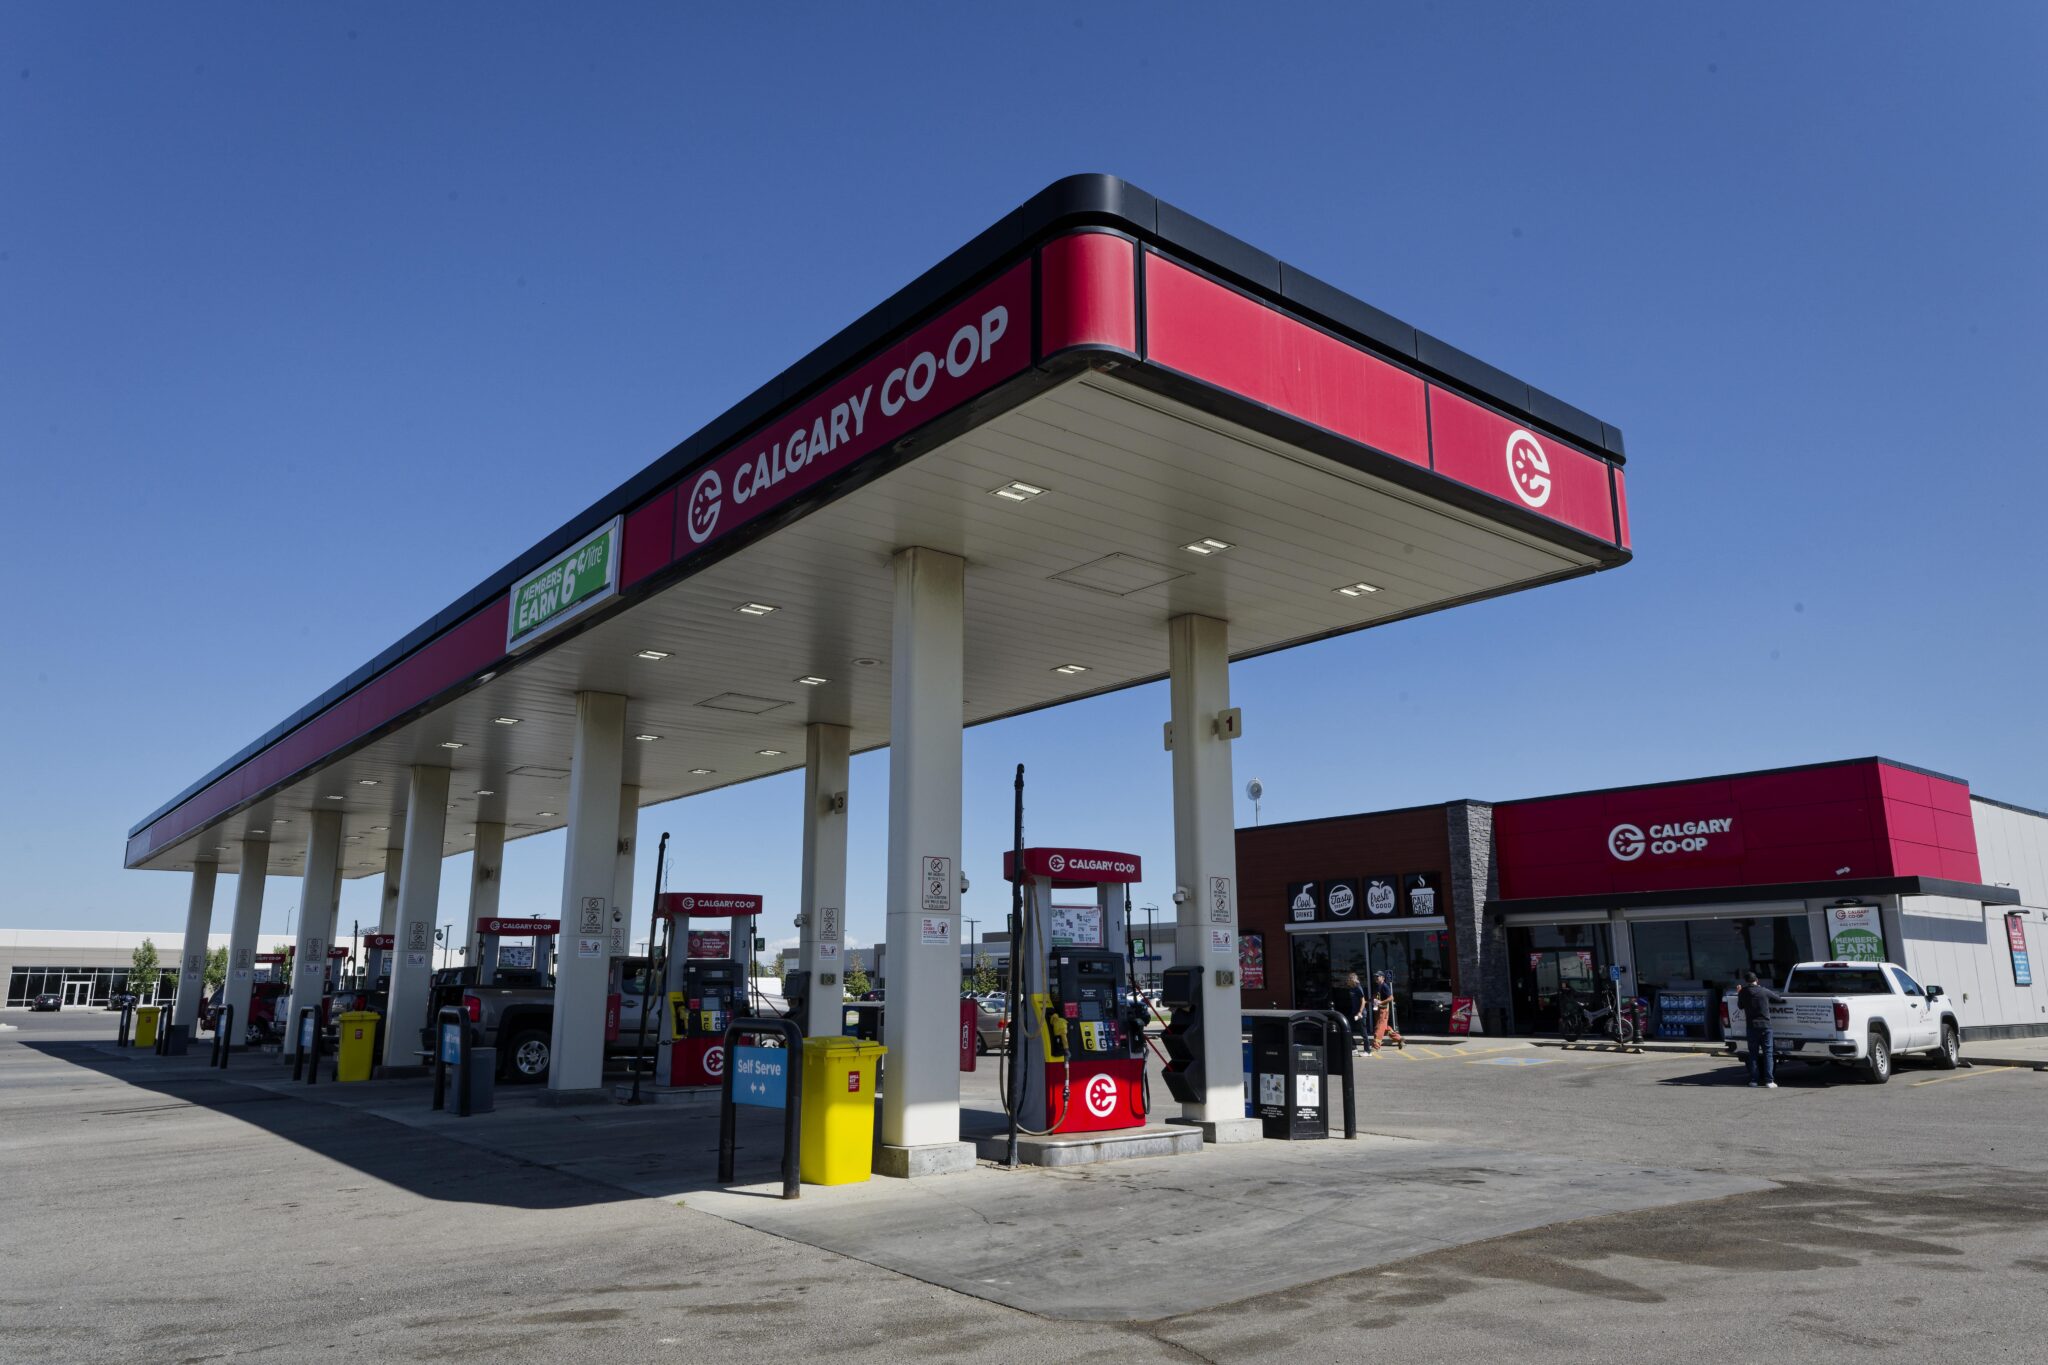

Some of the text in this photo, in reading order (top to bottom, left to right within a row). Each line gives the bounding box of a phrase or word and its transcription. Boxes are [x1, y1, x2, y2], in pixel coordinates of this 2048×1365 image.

[732, 384, 873, 504] CALGARY
[521, 567, 562, 604] MEMBERS
[518, 586, 560, 629] EARN
[1225, 715, 1233, 732] 1
[838, 796, 844, 808] 3
[1650, 817, 1733, 839] CALGARY
[1069, 858, 1113, 872] CALGARY
[698, 899, 734, 908] CALGARY
[1296, 895, 1311, 908] Cool
[1331, 893, 1353, 905] Tasty
[1370, 887, 1389, 908] fresh
[1835, 936, 1878, 944] MEMBERS
[1837, 943, 1878, 954] EARN
[738, 1058, 782, 1077] Self Serve
